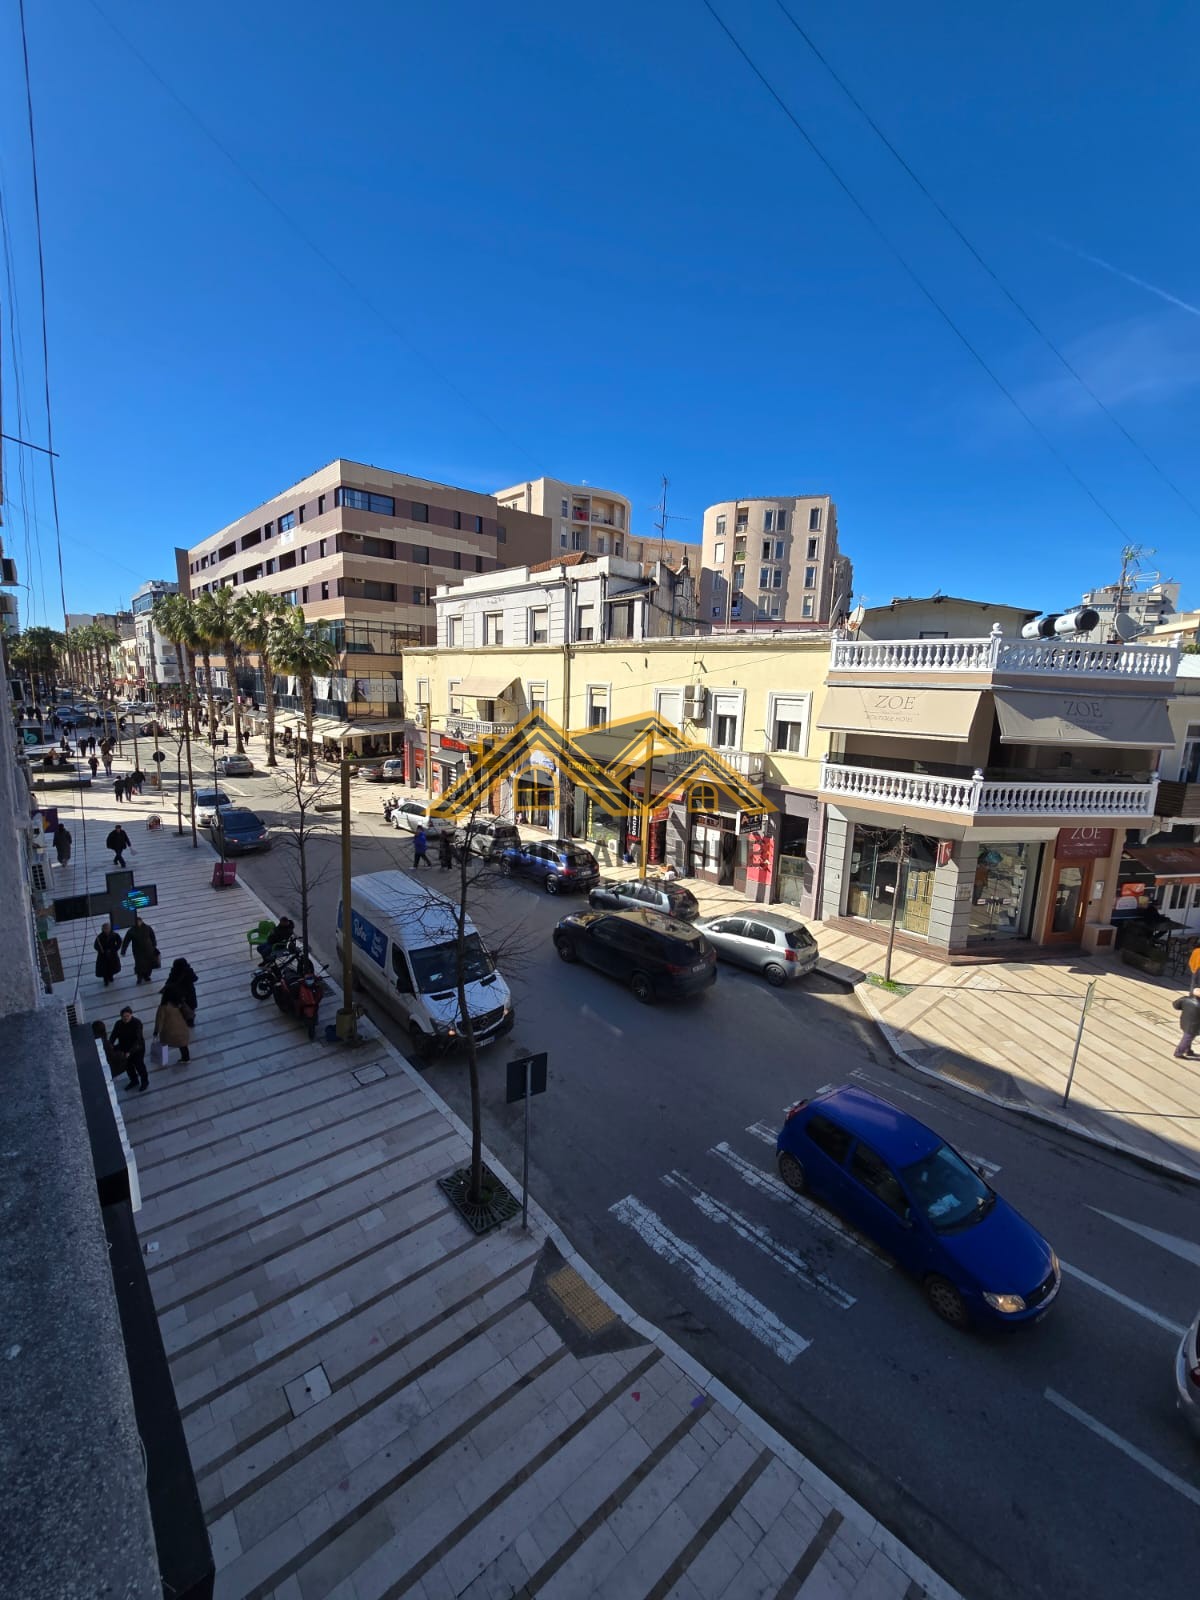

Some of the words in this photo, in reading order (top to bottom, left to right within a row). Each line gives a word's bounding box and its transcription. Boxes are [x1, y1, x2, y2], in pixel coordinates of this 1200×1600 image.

[874, 695, 916, 709] ZOE
[1063, 700, 1103, 717] ZOE
[1070, 827, 1102, 840] ZOE
